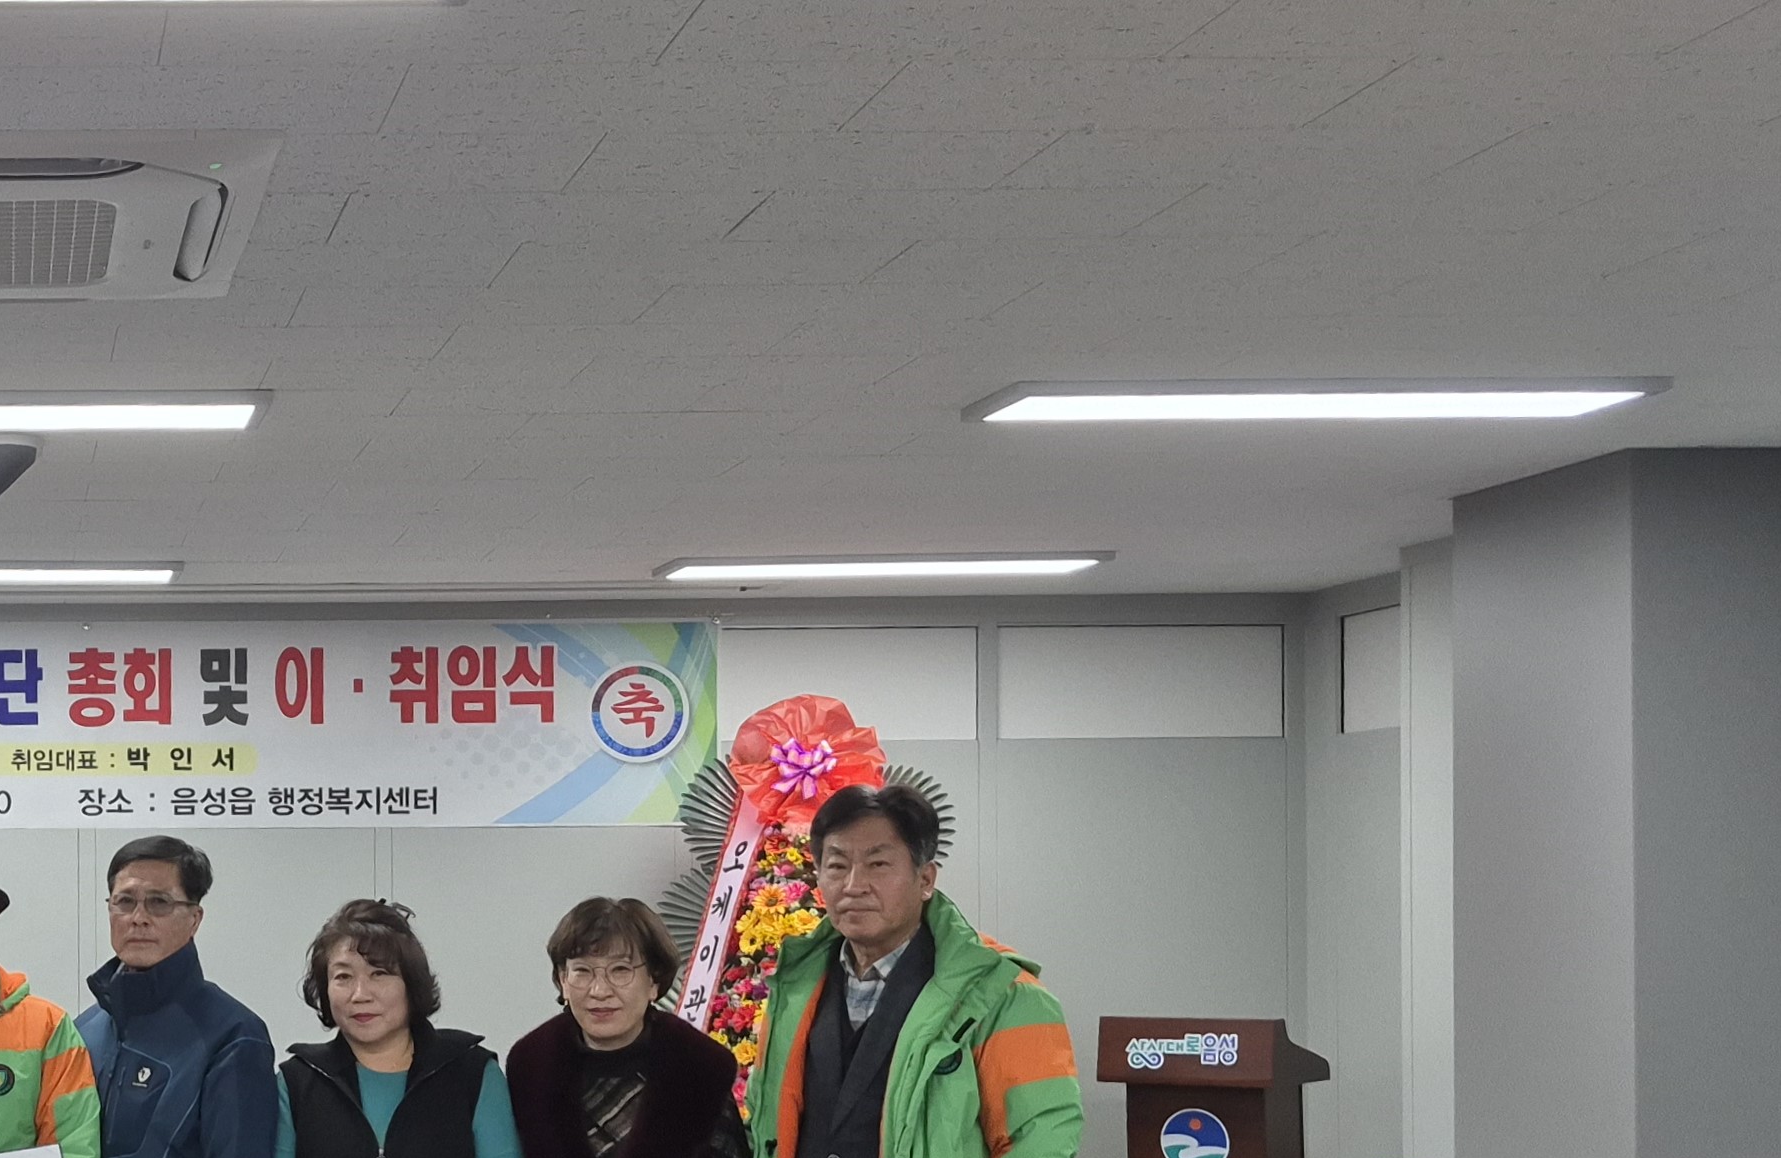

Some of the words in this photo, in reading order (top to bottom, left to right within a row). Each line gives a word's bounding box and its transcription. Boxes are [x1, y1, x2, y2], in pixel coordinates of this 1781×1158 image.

[67, 648, 171, 727] 총회
[200, 648, 248, 726] 및
[275, 647, 323, 724] 이
[389, 645, 555, 724] 취임식
[611, 683, 665, 738] 축
[11, 749, 98, 771] 취임대표
[78, 788, 133, 816] 장소
[171, 787, 256, 816] 음성읍
[268, 787, 437, 816] 행정복지센터
[1201, 1033, 1238, 1065] 음성
